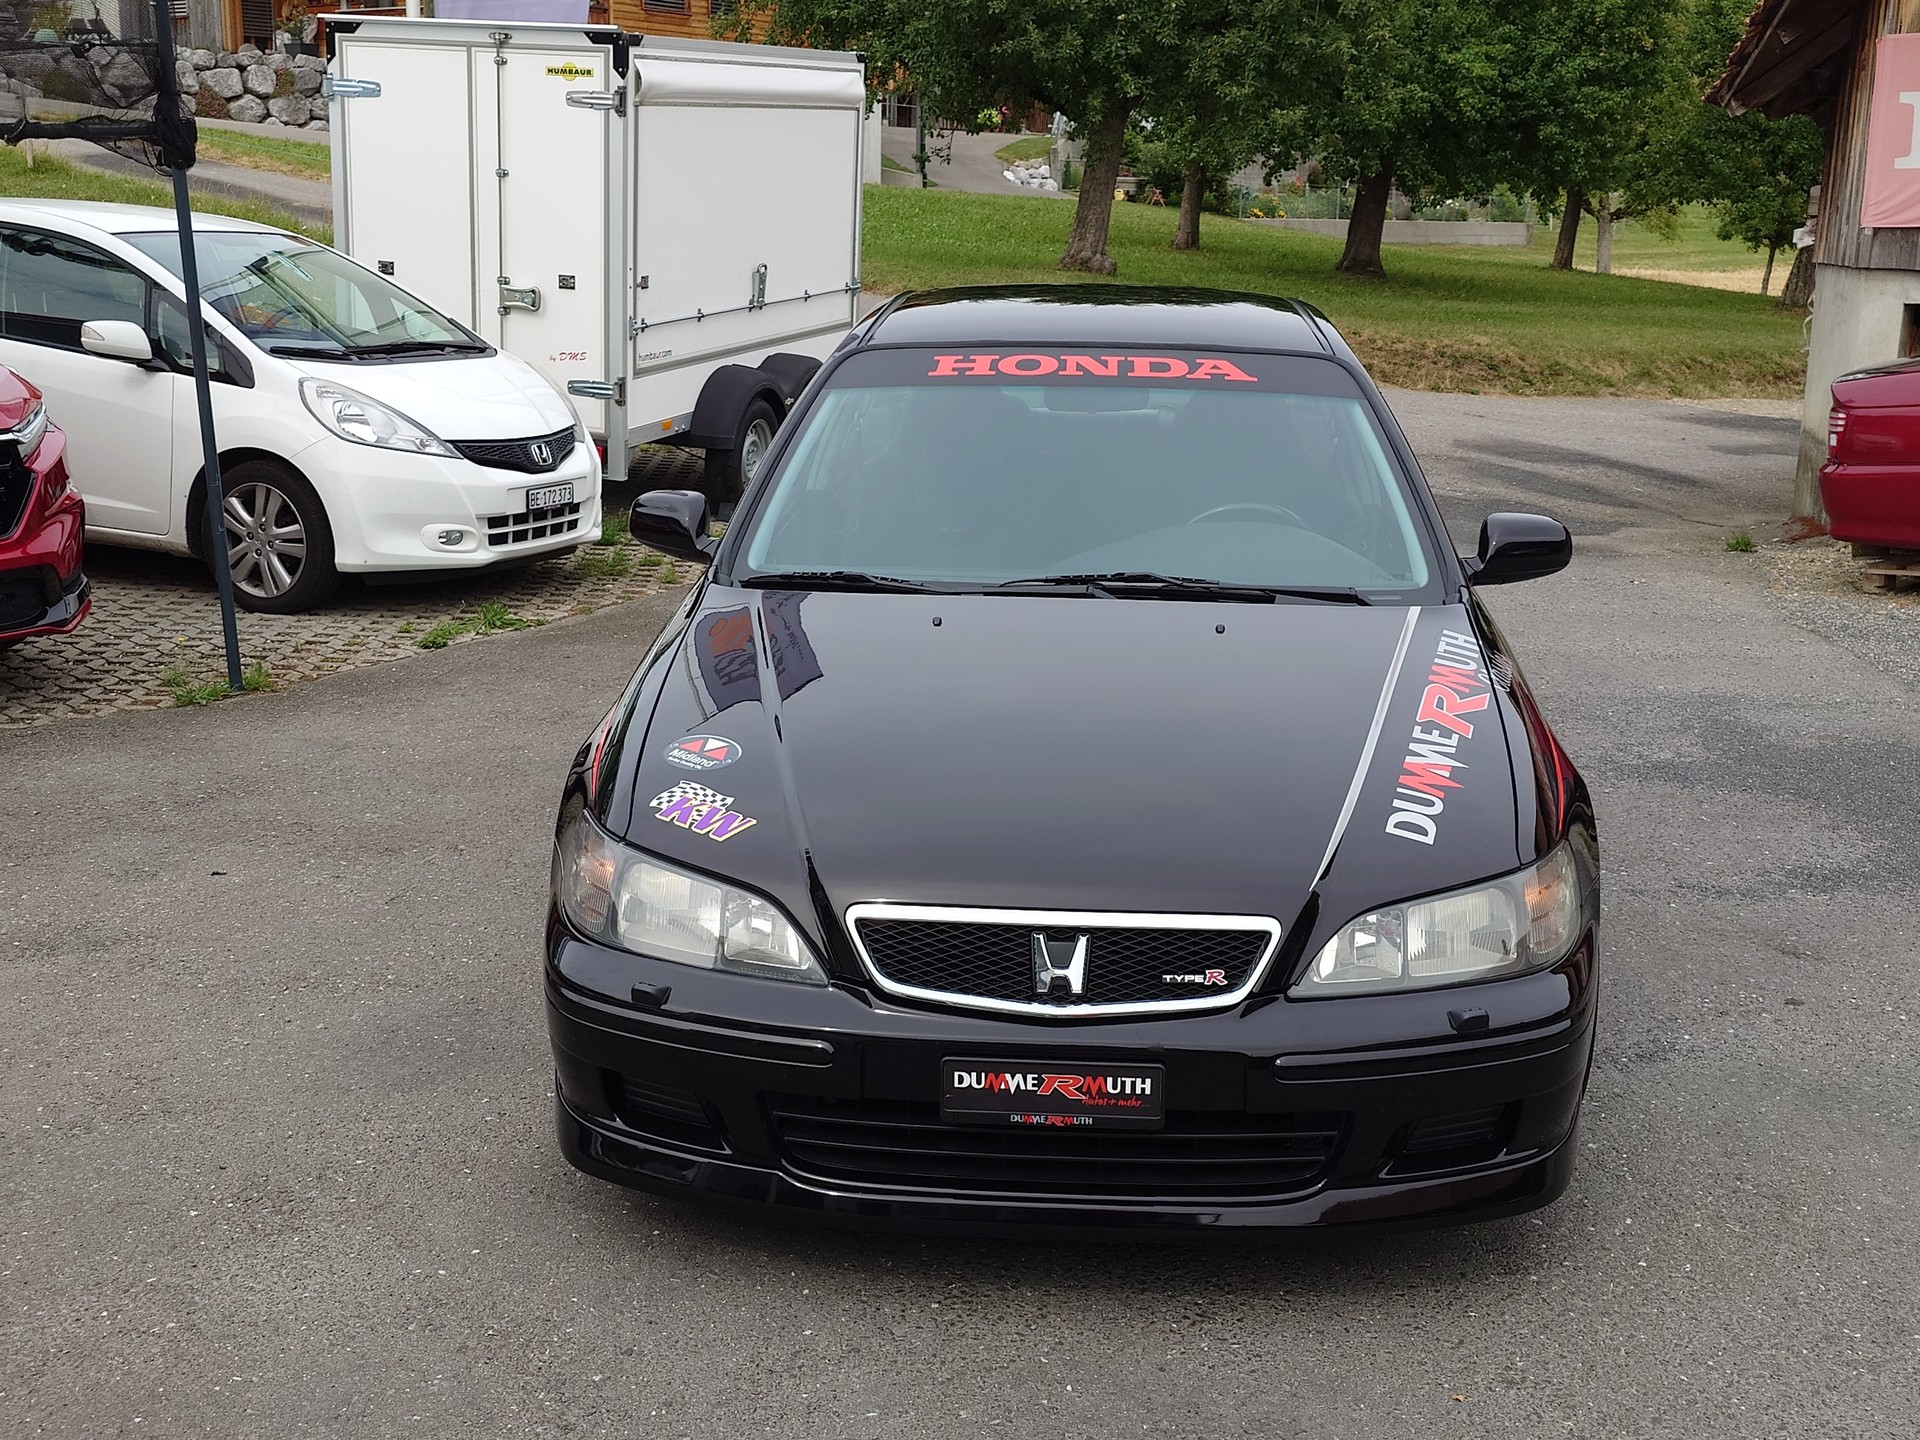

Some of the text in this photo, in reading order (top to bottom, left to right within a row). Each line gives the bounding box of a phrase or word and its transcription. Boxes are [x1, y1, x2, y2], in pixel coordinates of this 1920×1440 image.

[547, 67, 592, 76] HUMBAUR
[559, 351, 587, 361] DMS
[928, 354, 1258, 382] HONDA
[669, 748, 717, 768] Midland
[655, 795, 757, 842] KW
[1162, 969, 1228, 985] TYPE R
